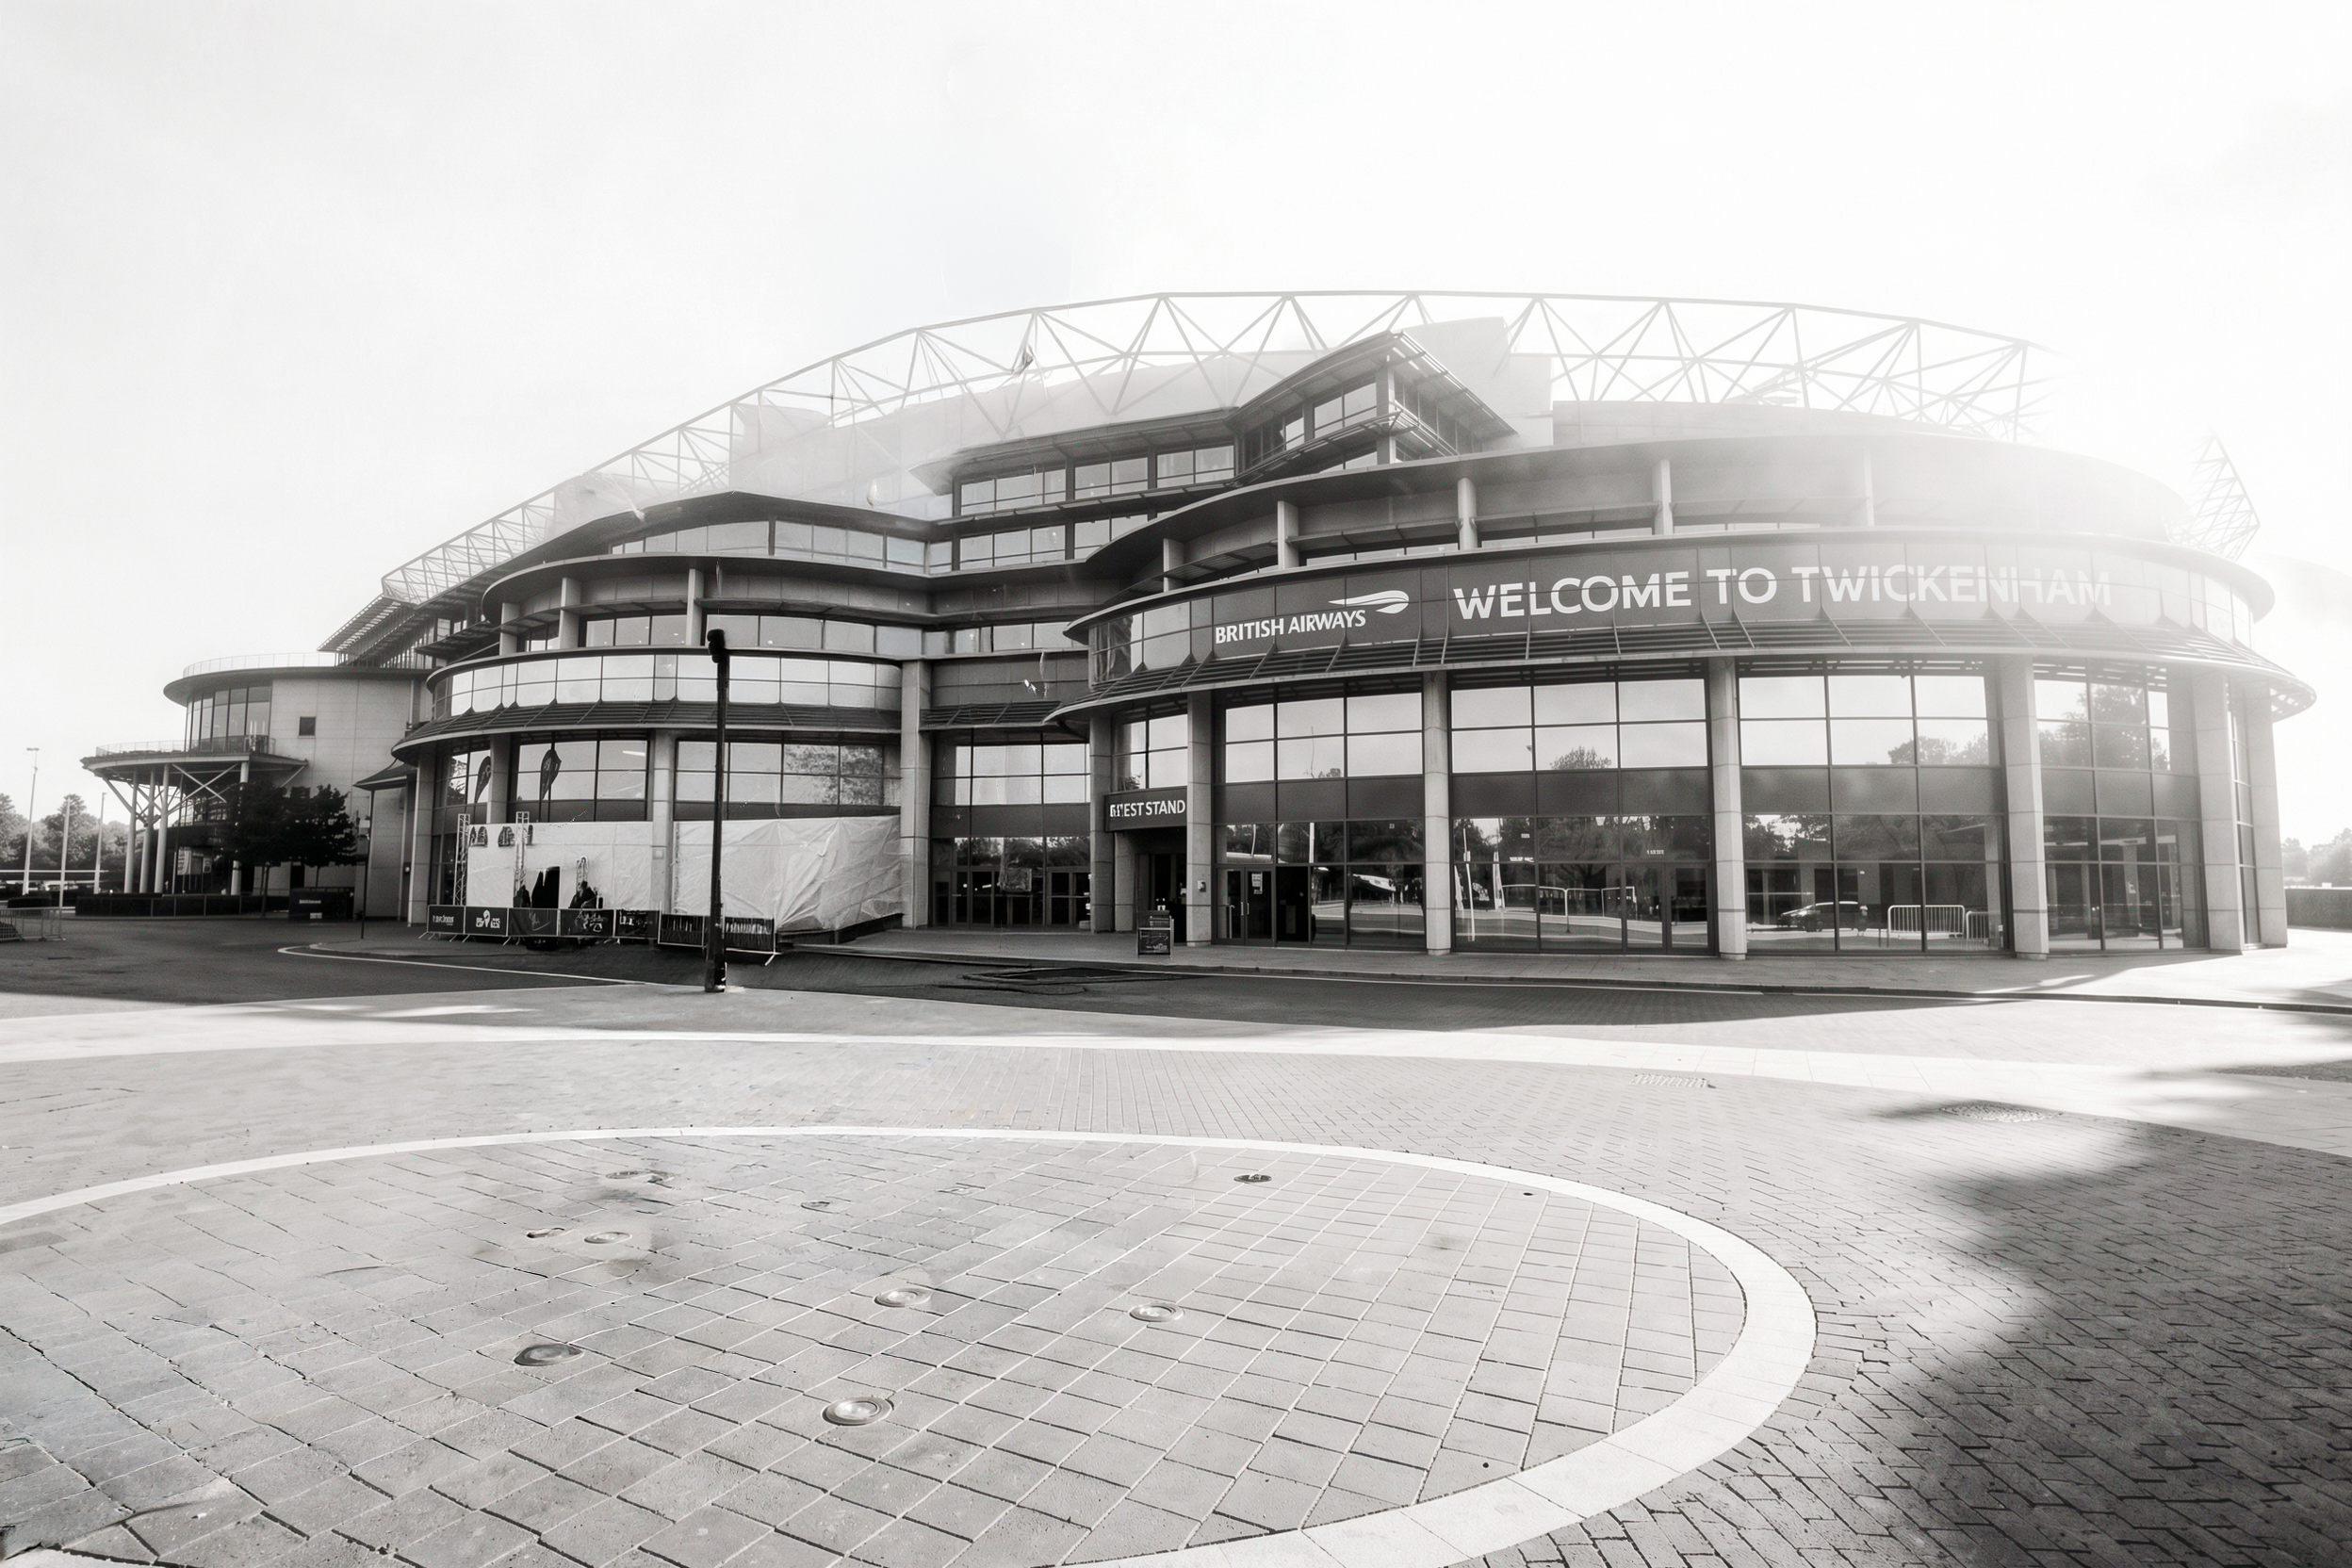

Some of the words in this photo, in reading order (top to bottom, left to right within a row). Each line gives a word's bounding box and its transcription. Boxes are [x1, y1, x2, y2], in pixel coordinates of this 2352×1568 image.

[1453, 571, 1691, 620] WELCOME
[1707, 567, 1777, 604] TO
[1790, 564, 2113, 607] TWICKENHAM
[1216, 618, 1284, 645] BRITISH
[1288, 610, 1366, 634] AIRWAYS
[1145, 799, 1186, 816] STAND
